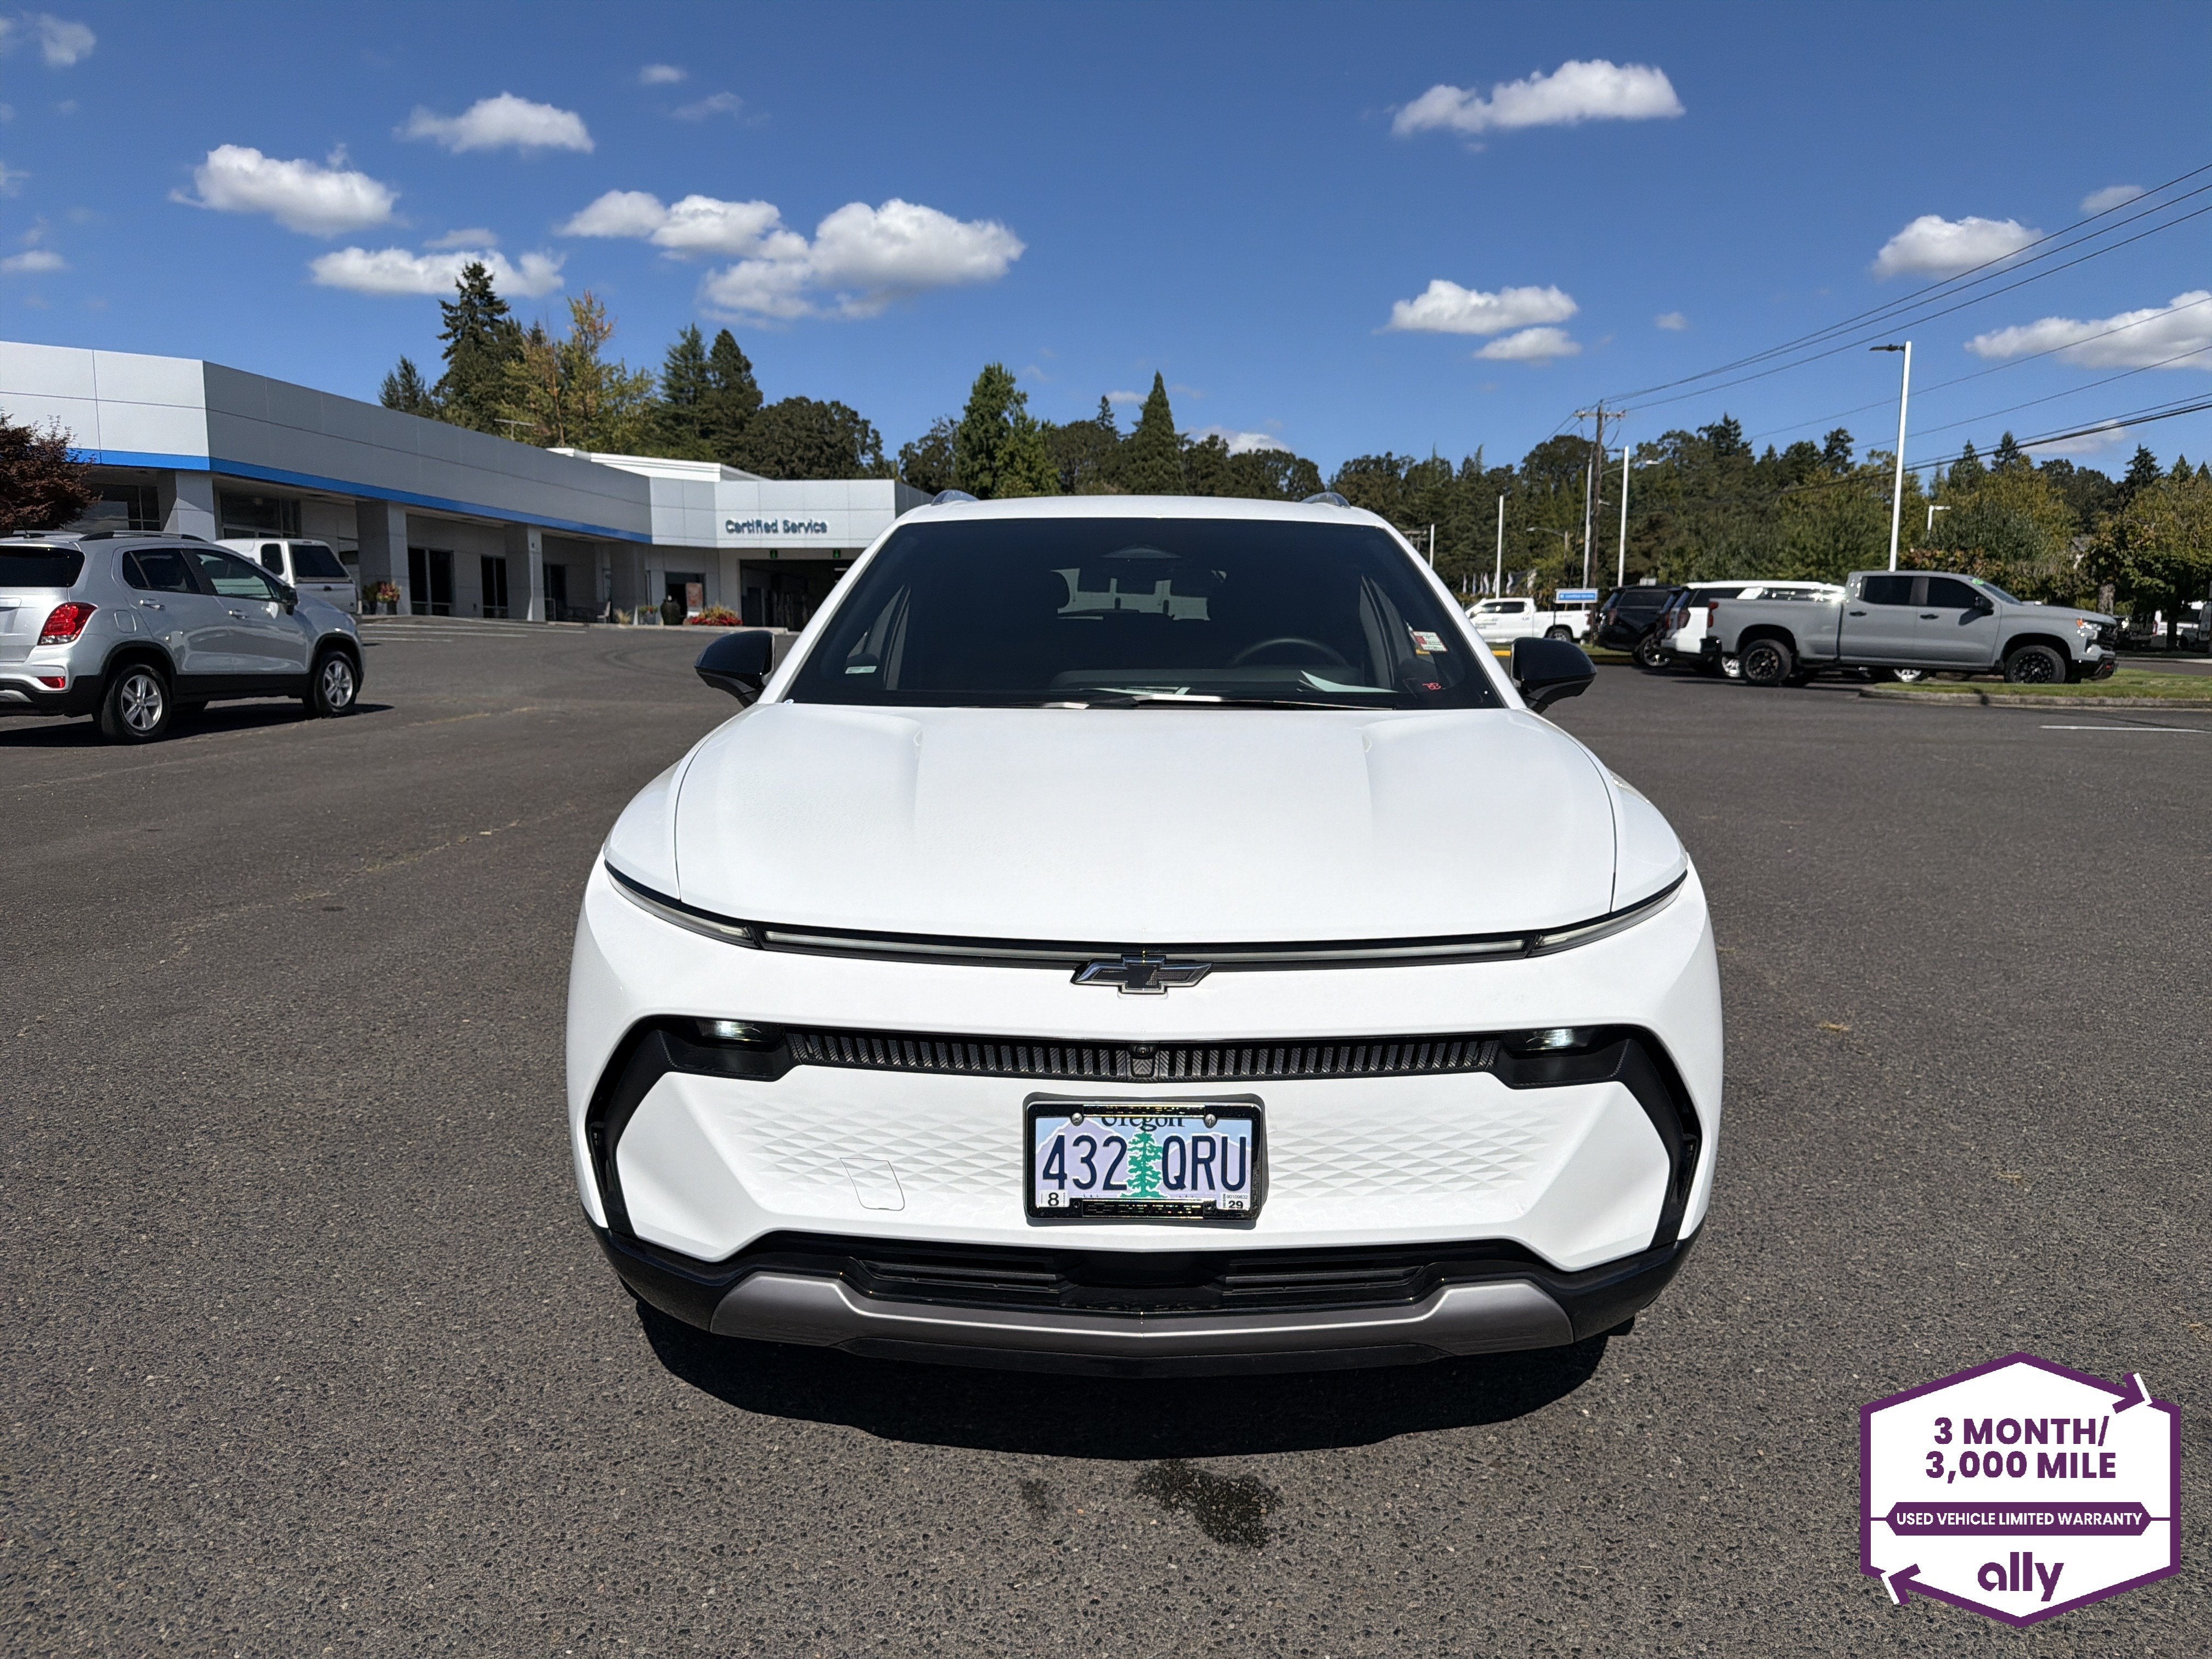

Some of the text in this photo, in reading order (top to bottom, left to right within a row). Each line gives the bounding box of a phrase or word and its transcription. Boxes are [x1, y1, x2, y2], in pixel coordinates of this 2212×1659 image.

[725, 519, 827, 534] Certified Service
[1042, 1135, 1246, 1192] 432 QRU
[1048, 1192, 1059, 1206] 8
[1228, 1200, 1244, 1209] 29
